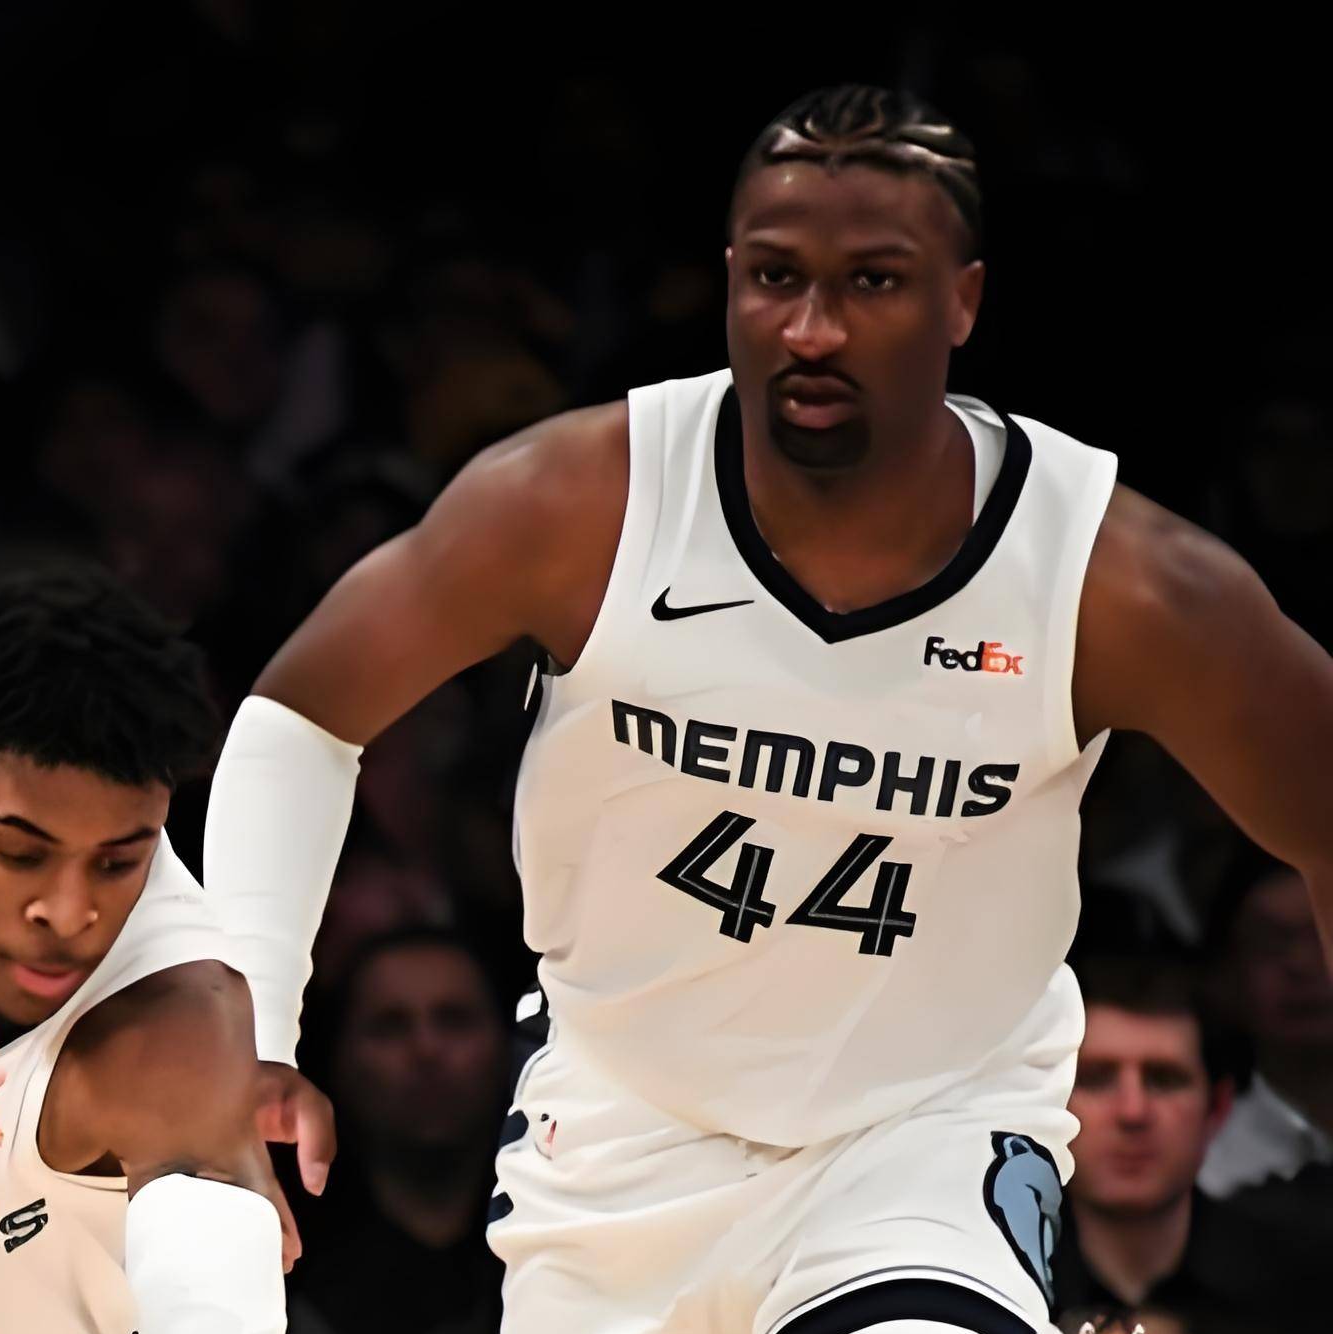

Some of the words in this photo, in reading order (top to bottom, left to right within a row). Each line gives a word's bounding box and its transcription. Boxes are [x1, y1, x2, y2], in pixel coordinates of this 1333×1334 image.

[923, 635, 1024, 675] FedEx
[611, 698, 1021, 819] MEMPHIS
[655, 809, 917, 958] 44
